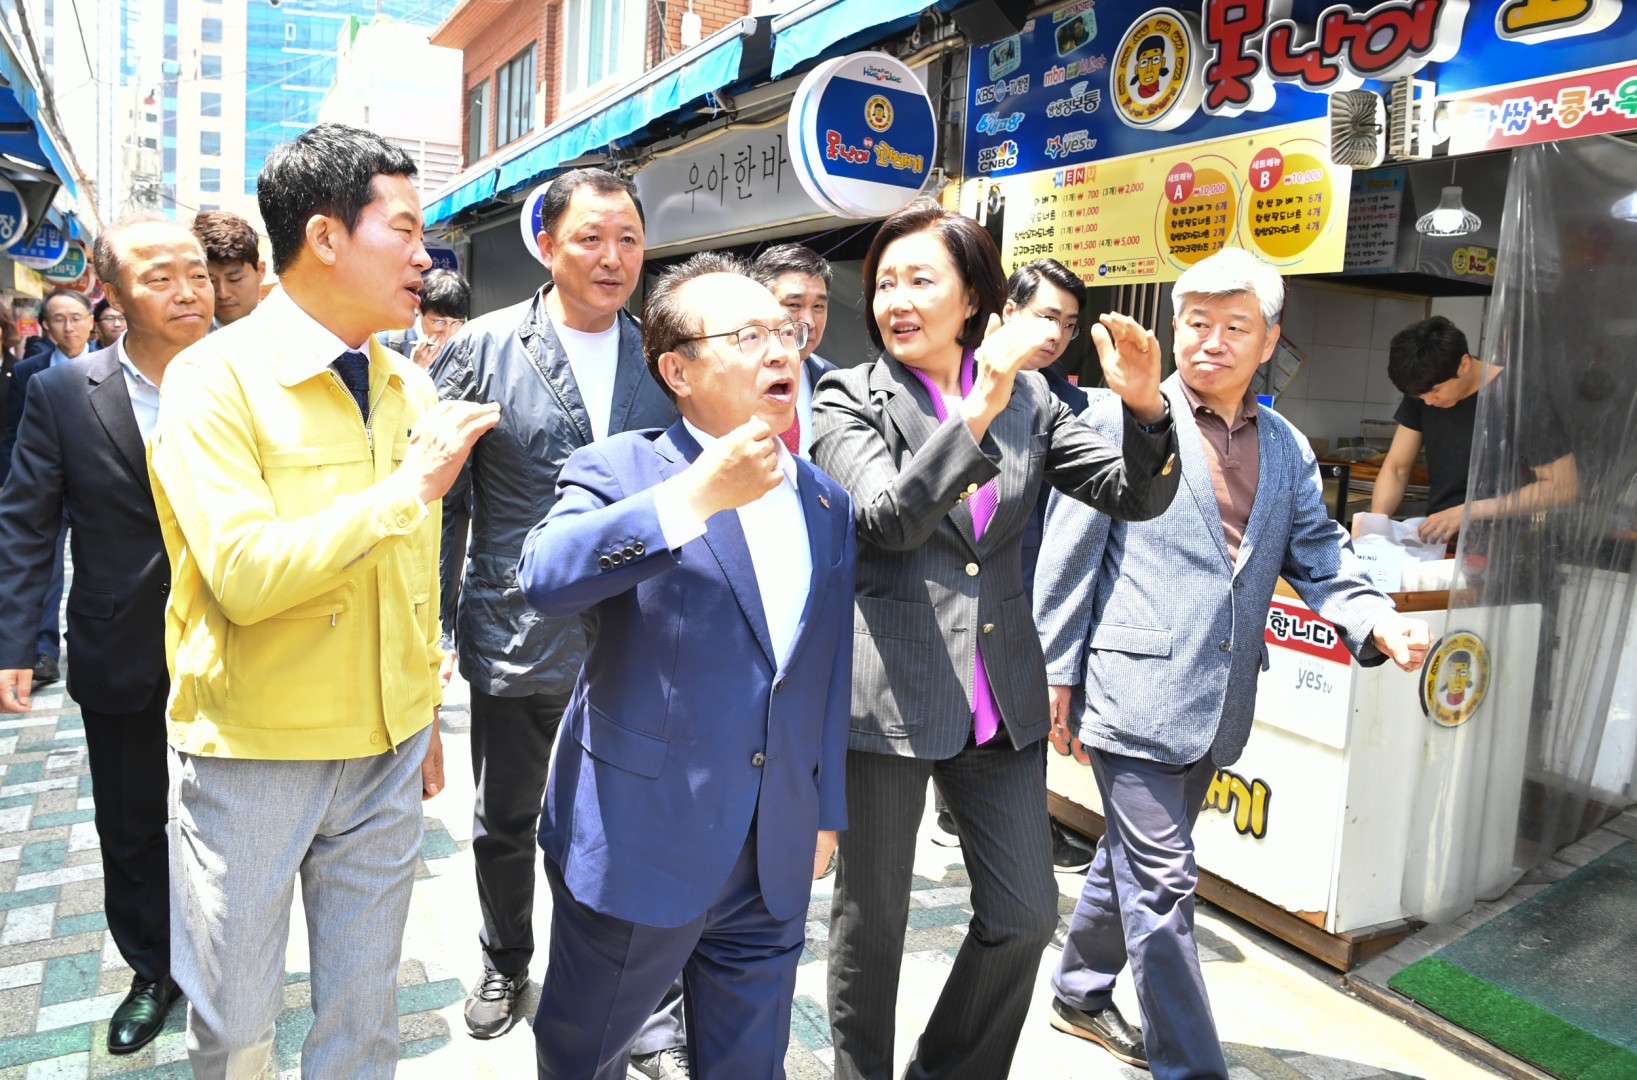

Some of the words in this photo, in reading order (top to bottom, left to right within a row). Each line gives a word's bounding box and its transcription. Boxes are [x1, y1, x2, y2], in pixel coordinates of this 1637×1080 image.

[1202, 0, 1446, 113] 못난이
[976, 85, 995, 105] KBS
[827, 130, 869, 163] 못난이
[874, 141, 923, 173] 꽈배기
[980, 148, 997, 161] SBS
[979, 157, 1015, 171] CNBC
[1252, 157, 1281, 170] 세트메뉴
[1054, 167, 1096, 186] MENU
[1167, 172, 1193, 182] 세트메뉴
[1260, 171, 1270, 188] B
[1063, 193, 1076, 202] (1개)
[1102, 186, 1117, 197] (3개)
[1173, 185, 1183, 200] A
[1308, 193, 1322, 203] 6개
[1215, 201, 1228, 211] 6개
[1307, 207, 1321, 217] 4개
[1062, 209, 1075, 219] (1개)
[1214, 214, 1227, 224] 2개
[1060, 226, 1073, 236] (1개)
[1213, 228, 1225, 237] 2개
[1306, 221, 1320, 231] 4개
[1059, 242, 1073, 252] (1개)
[1099, 239, 1113, 248] (4개)
[1270, 610, 1335, 646] 합니다
